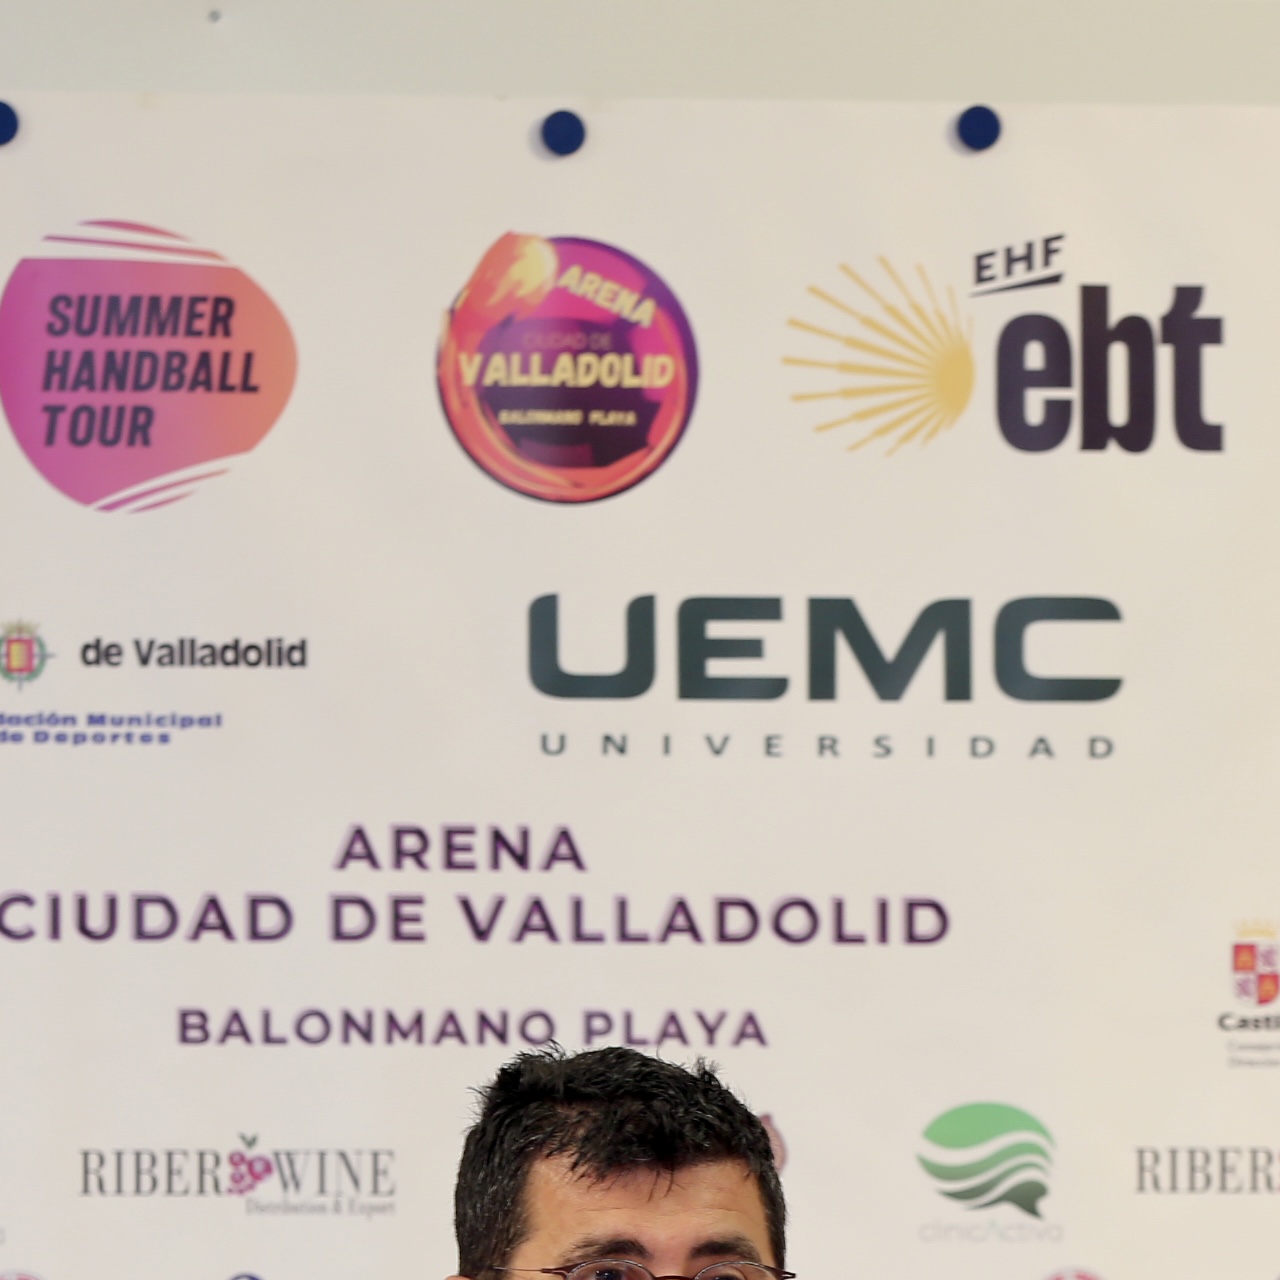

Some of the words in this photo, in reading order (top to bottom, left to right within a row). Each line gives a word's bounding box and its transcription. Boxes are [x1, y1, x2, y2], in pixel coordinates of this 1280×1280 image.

[972, 233, 1066, 285] EHF
[45, 293, 237, 338] SUMMER
[556, 263, 657, 329] ARENA
[41, 349, 260, 393] HANDBALL
[458, 352, 676, 389] VALLADOLID
[994, 284, 1225, 453] ebt
[41, 403, 155, 447] TOUR
[588, 409, 638, 427] PLAYA
[80, 637, 123, 667] de
[134, 636, 308, 668] Valladolid
[528, 593, 1125, 702] UEMC
[33, 730, 171, 745] Deportes
[87, 711, 223, 729] Municipal
[540, 733, 1115, 760] UNIVERSIDAD
[335, 825, 587, 871] ARENA
[331, 895, 428, 943] DE
[458, 896, 952, 947] VALLADOLID
[177, 1008, 559, 1047] BALONMANO
[584, 1010, 770, 1047] PLAYA
[80, 1149, 222, 1196] RIBER
[272, 1149, 397, 1196] WINE
[1134, 1148, 1275, 1194] RIBER
